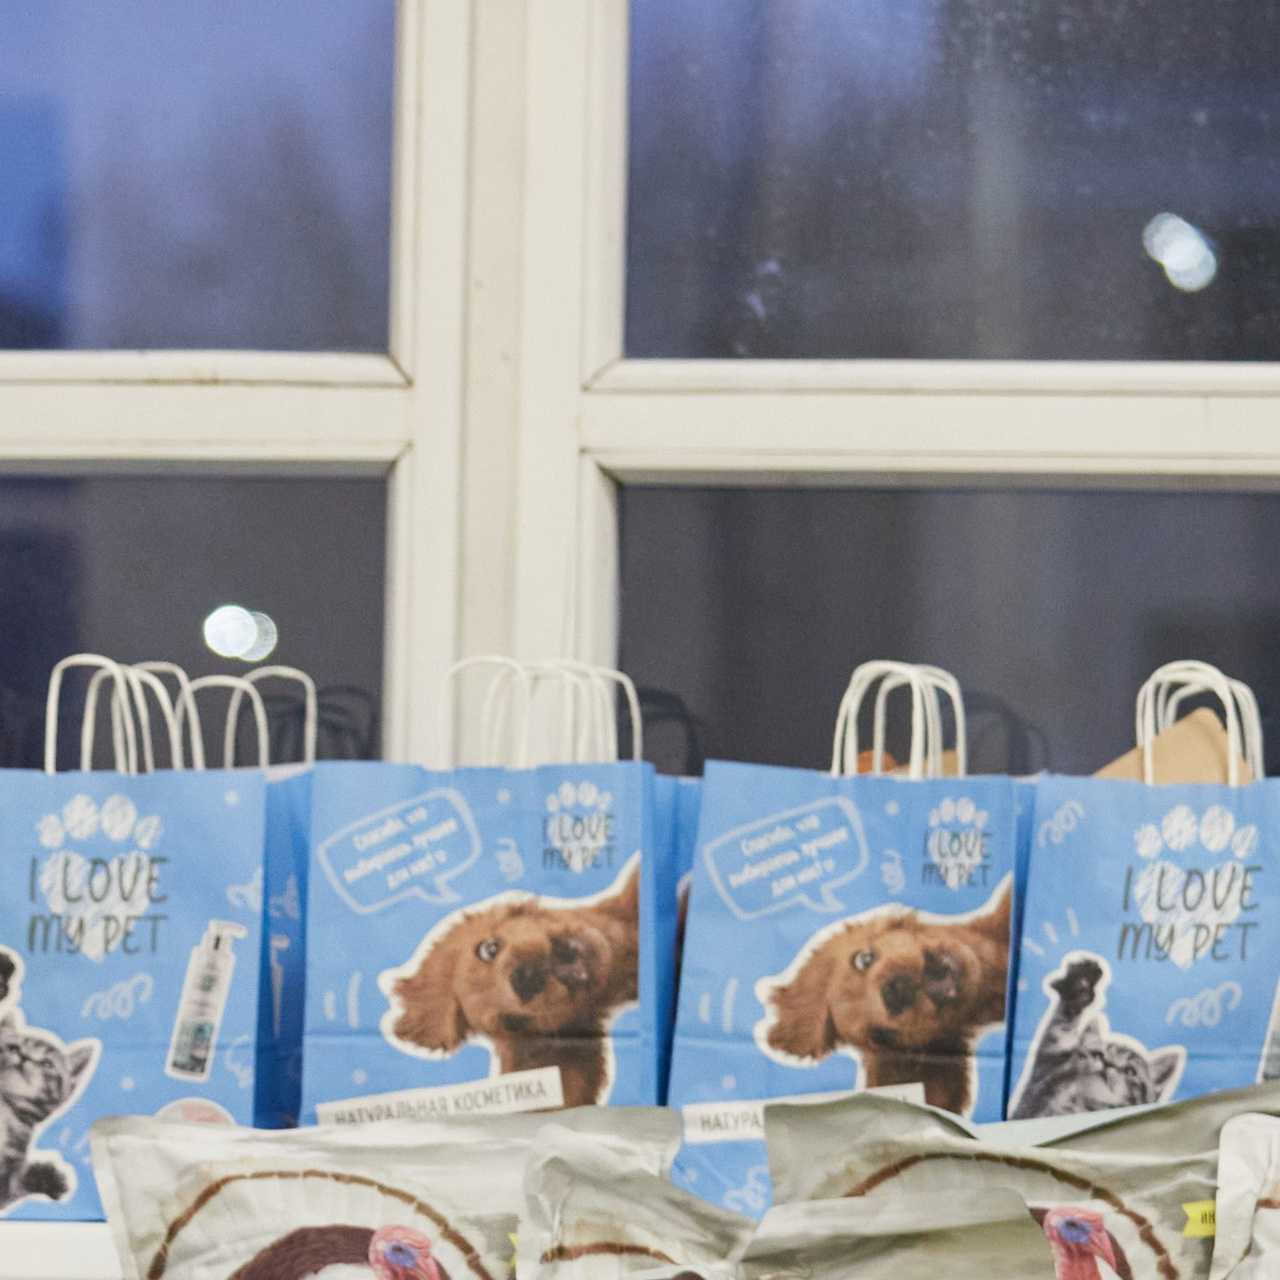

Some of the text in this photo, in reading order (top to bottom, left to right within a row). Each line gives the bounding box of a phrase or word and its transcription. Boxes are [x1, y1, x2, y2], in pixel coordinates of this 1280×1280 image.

[29, 856, 168, 904] I LOVE
[1123, 864, 1263, 912] I LOVE
[103, 914, 169, 954] PET
[1193, 922, 1258, 961] PET
[452, 1079, 547, 1113] КОСМЕТИКА
[700, 1110, 764, 1132] НАТУРА
